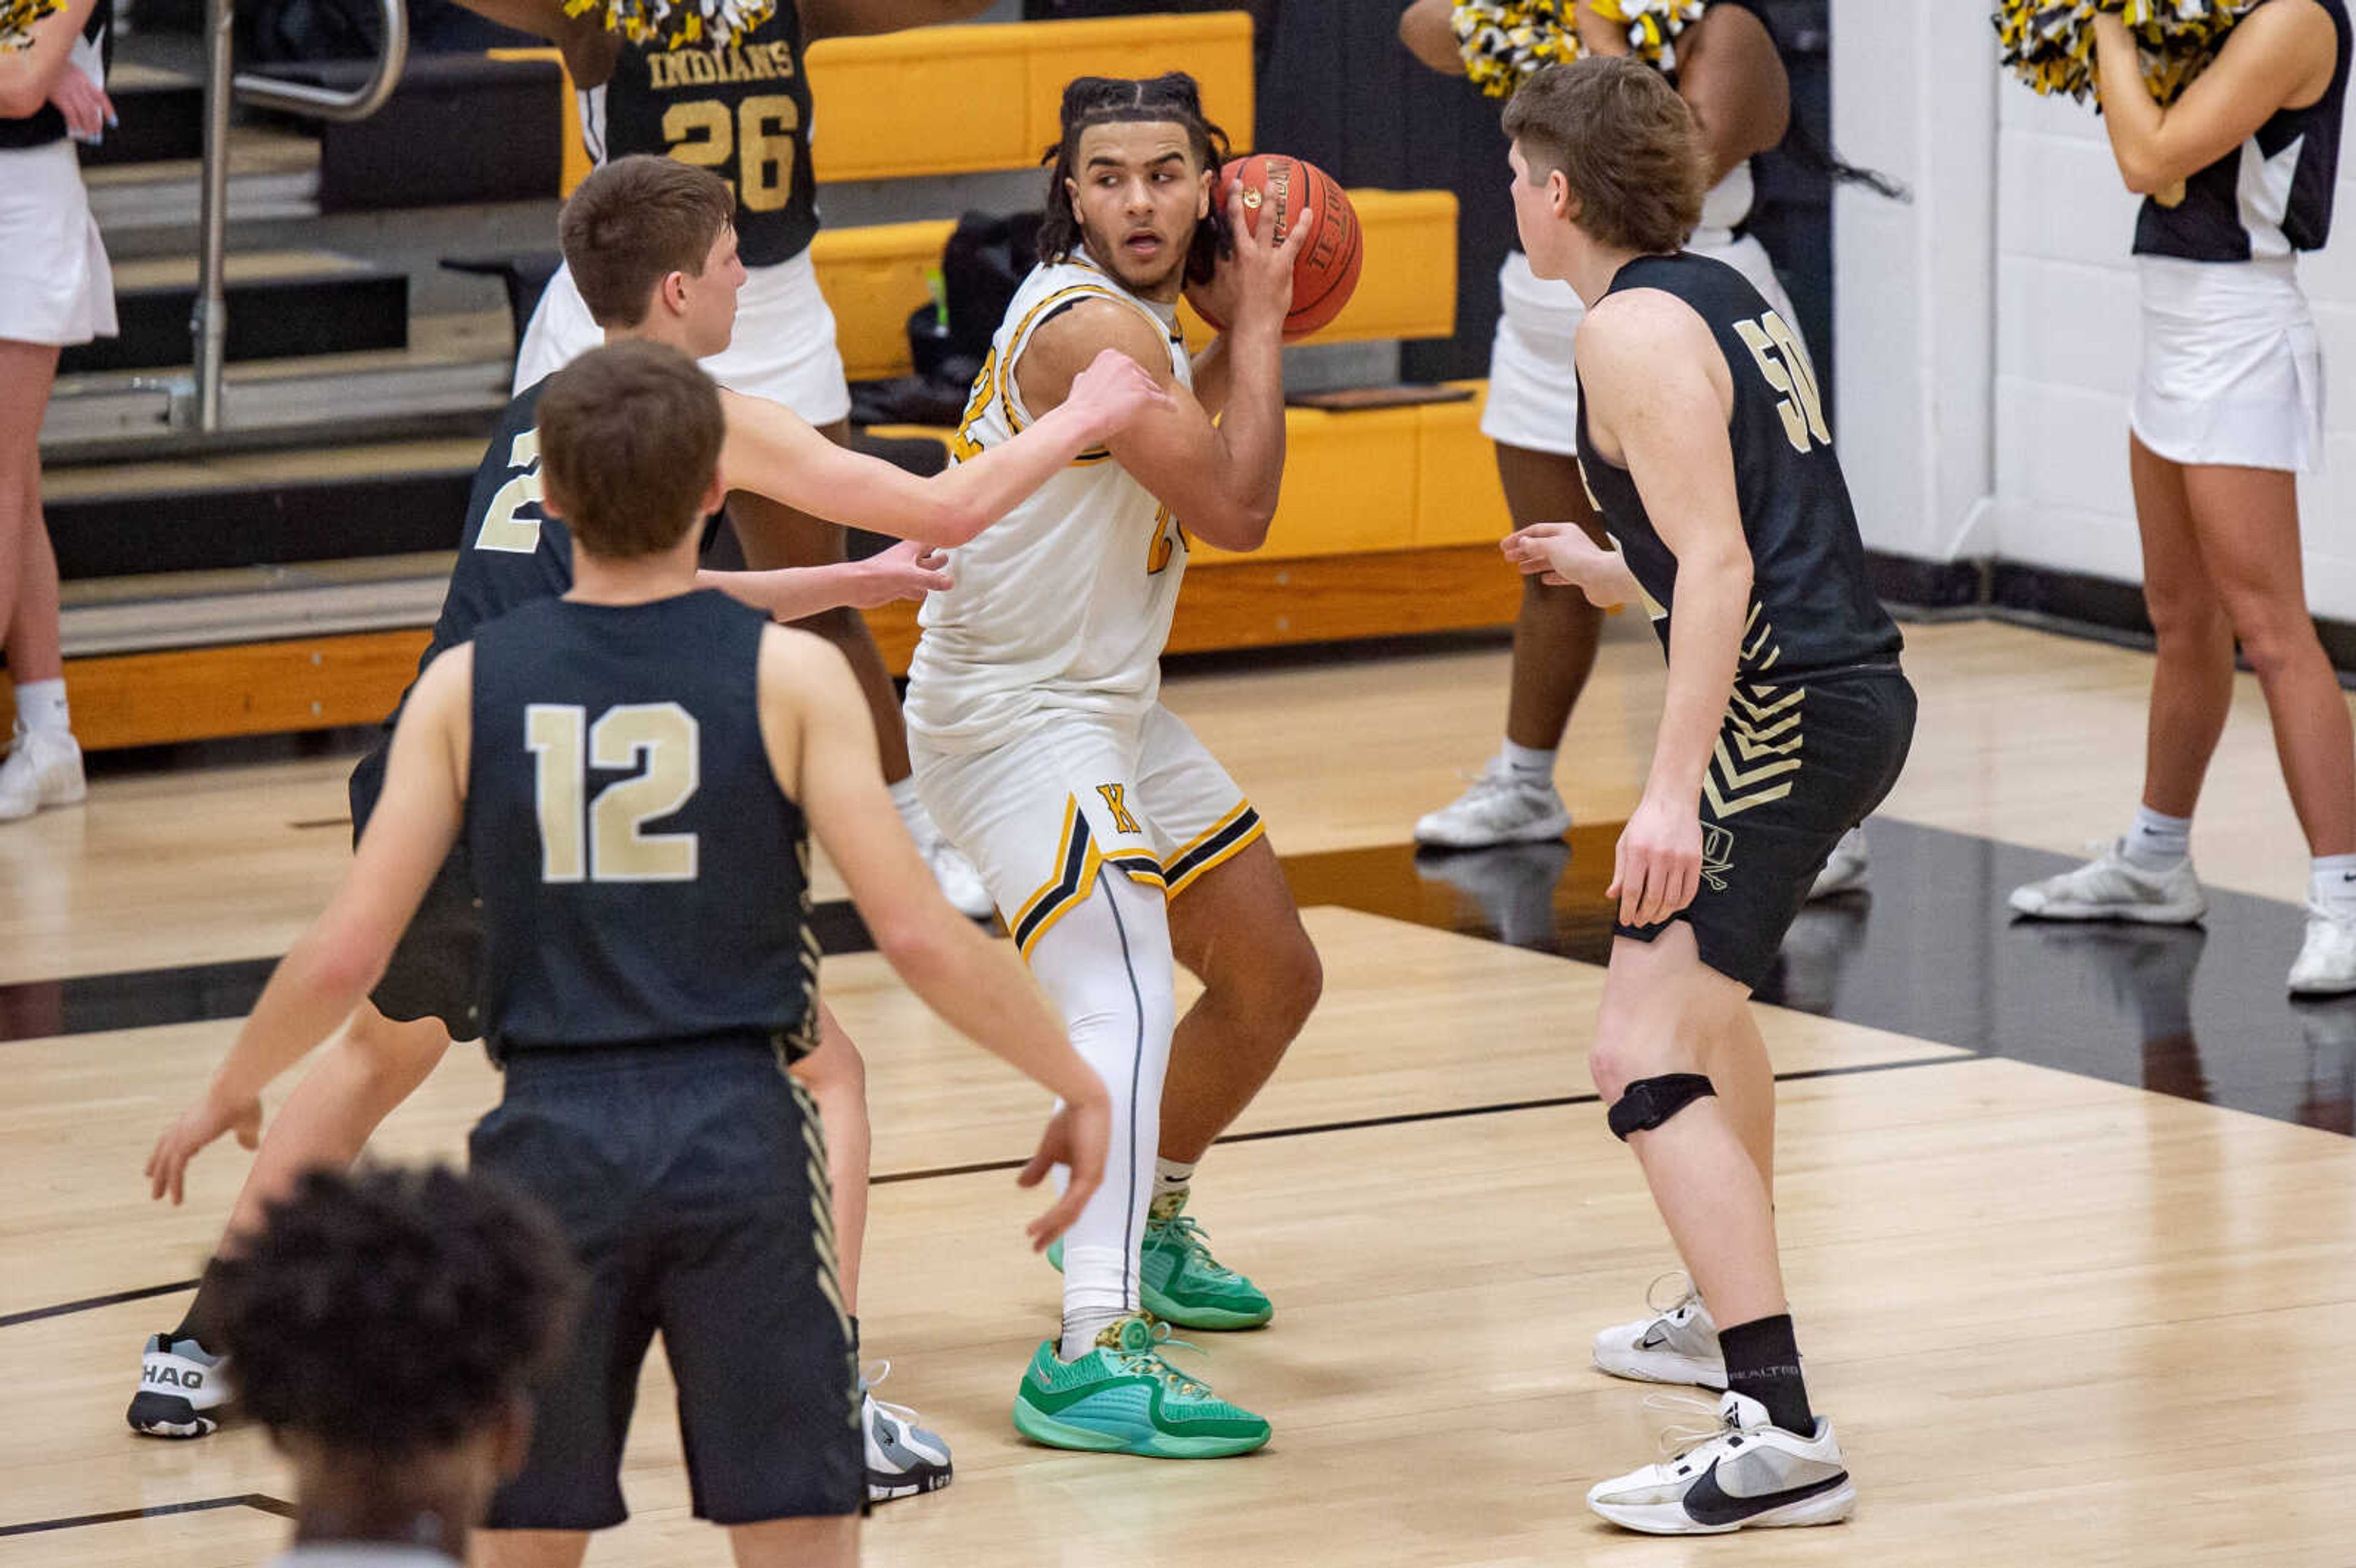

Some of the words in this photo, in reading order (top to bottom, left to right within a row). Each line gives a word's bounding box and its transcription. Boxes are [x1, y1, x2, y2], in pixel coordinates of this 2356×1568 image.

[647, 40, 794, 89] INDIANS
[662, 94, 798, 212] 26
[1732, 310, 1832, 454] 50
[525, 701, 701, 883] 12
[1095, 783, 1142, 834] K
[142, 1364, 204, 1389] HAQ
